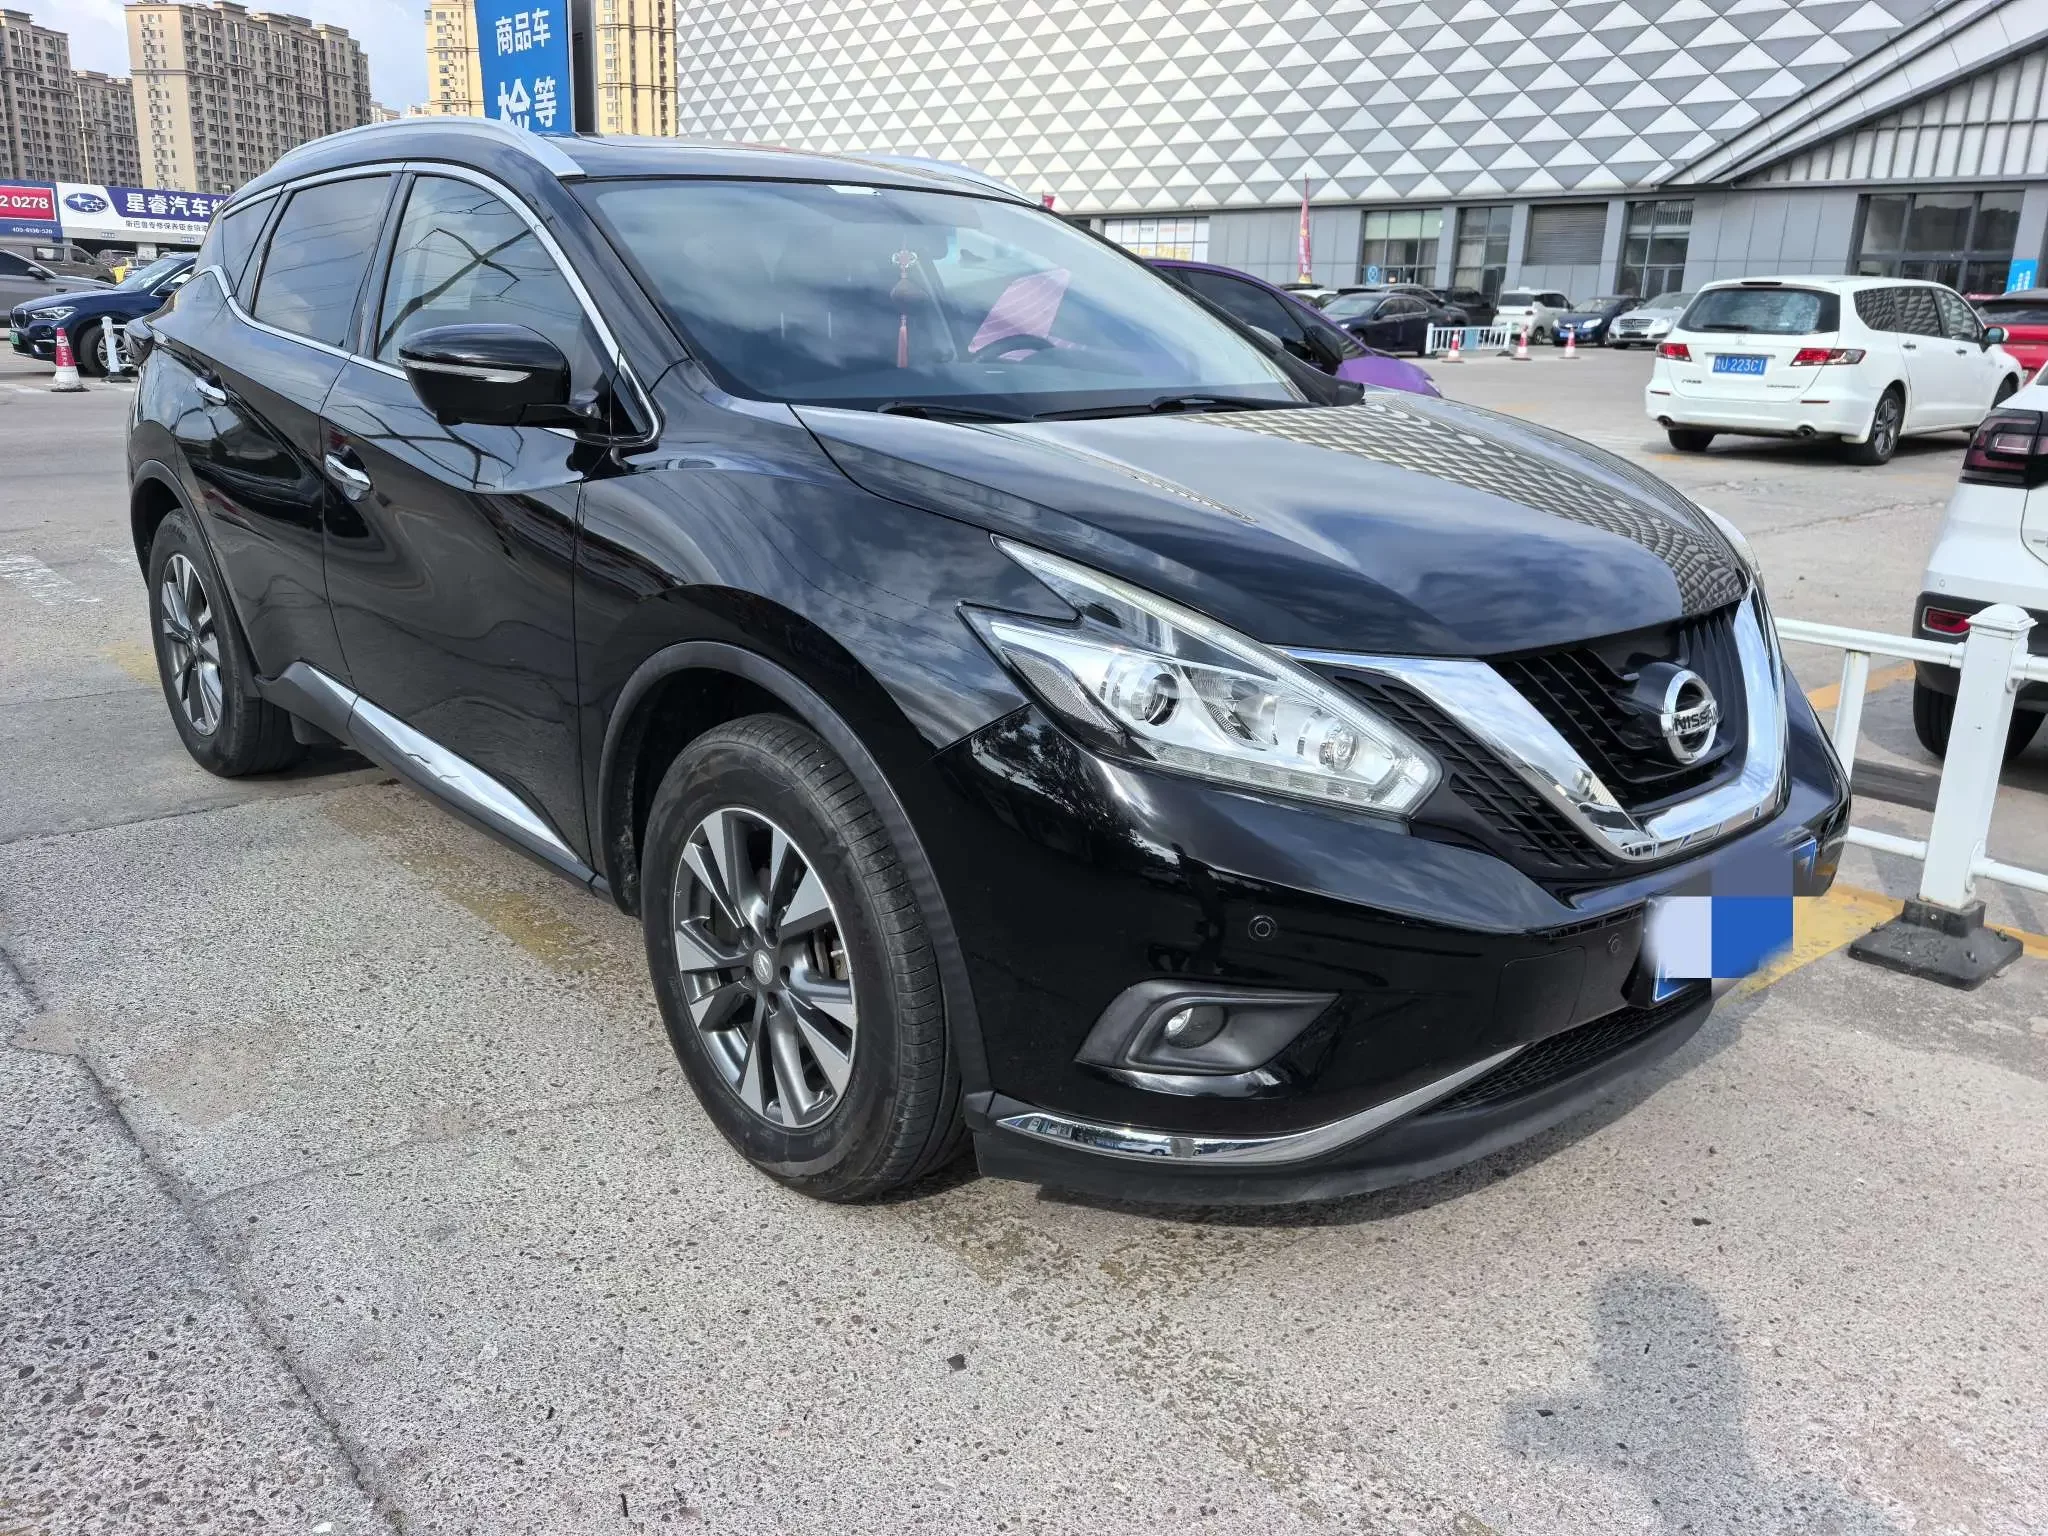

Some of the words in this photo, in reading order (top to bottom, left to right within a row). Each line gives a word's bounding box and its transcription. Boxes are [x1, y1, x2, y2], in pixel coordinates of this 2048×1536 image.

[495, 8, 551, 56] 商品车
[12, 196, 49, 209] 0278
[1673, 704, 1719, 731] NISSAN
